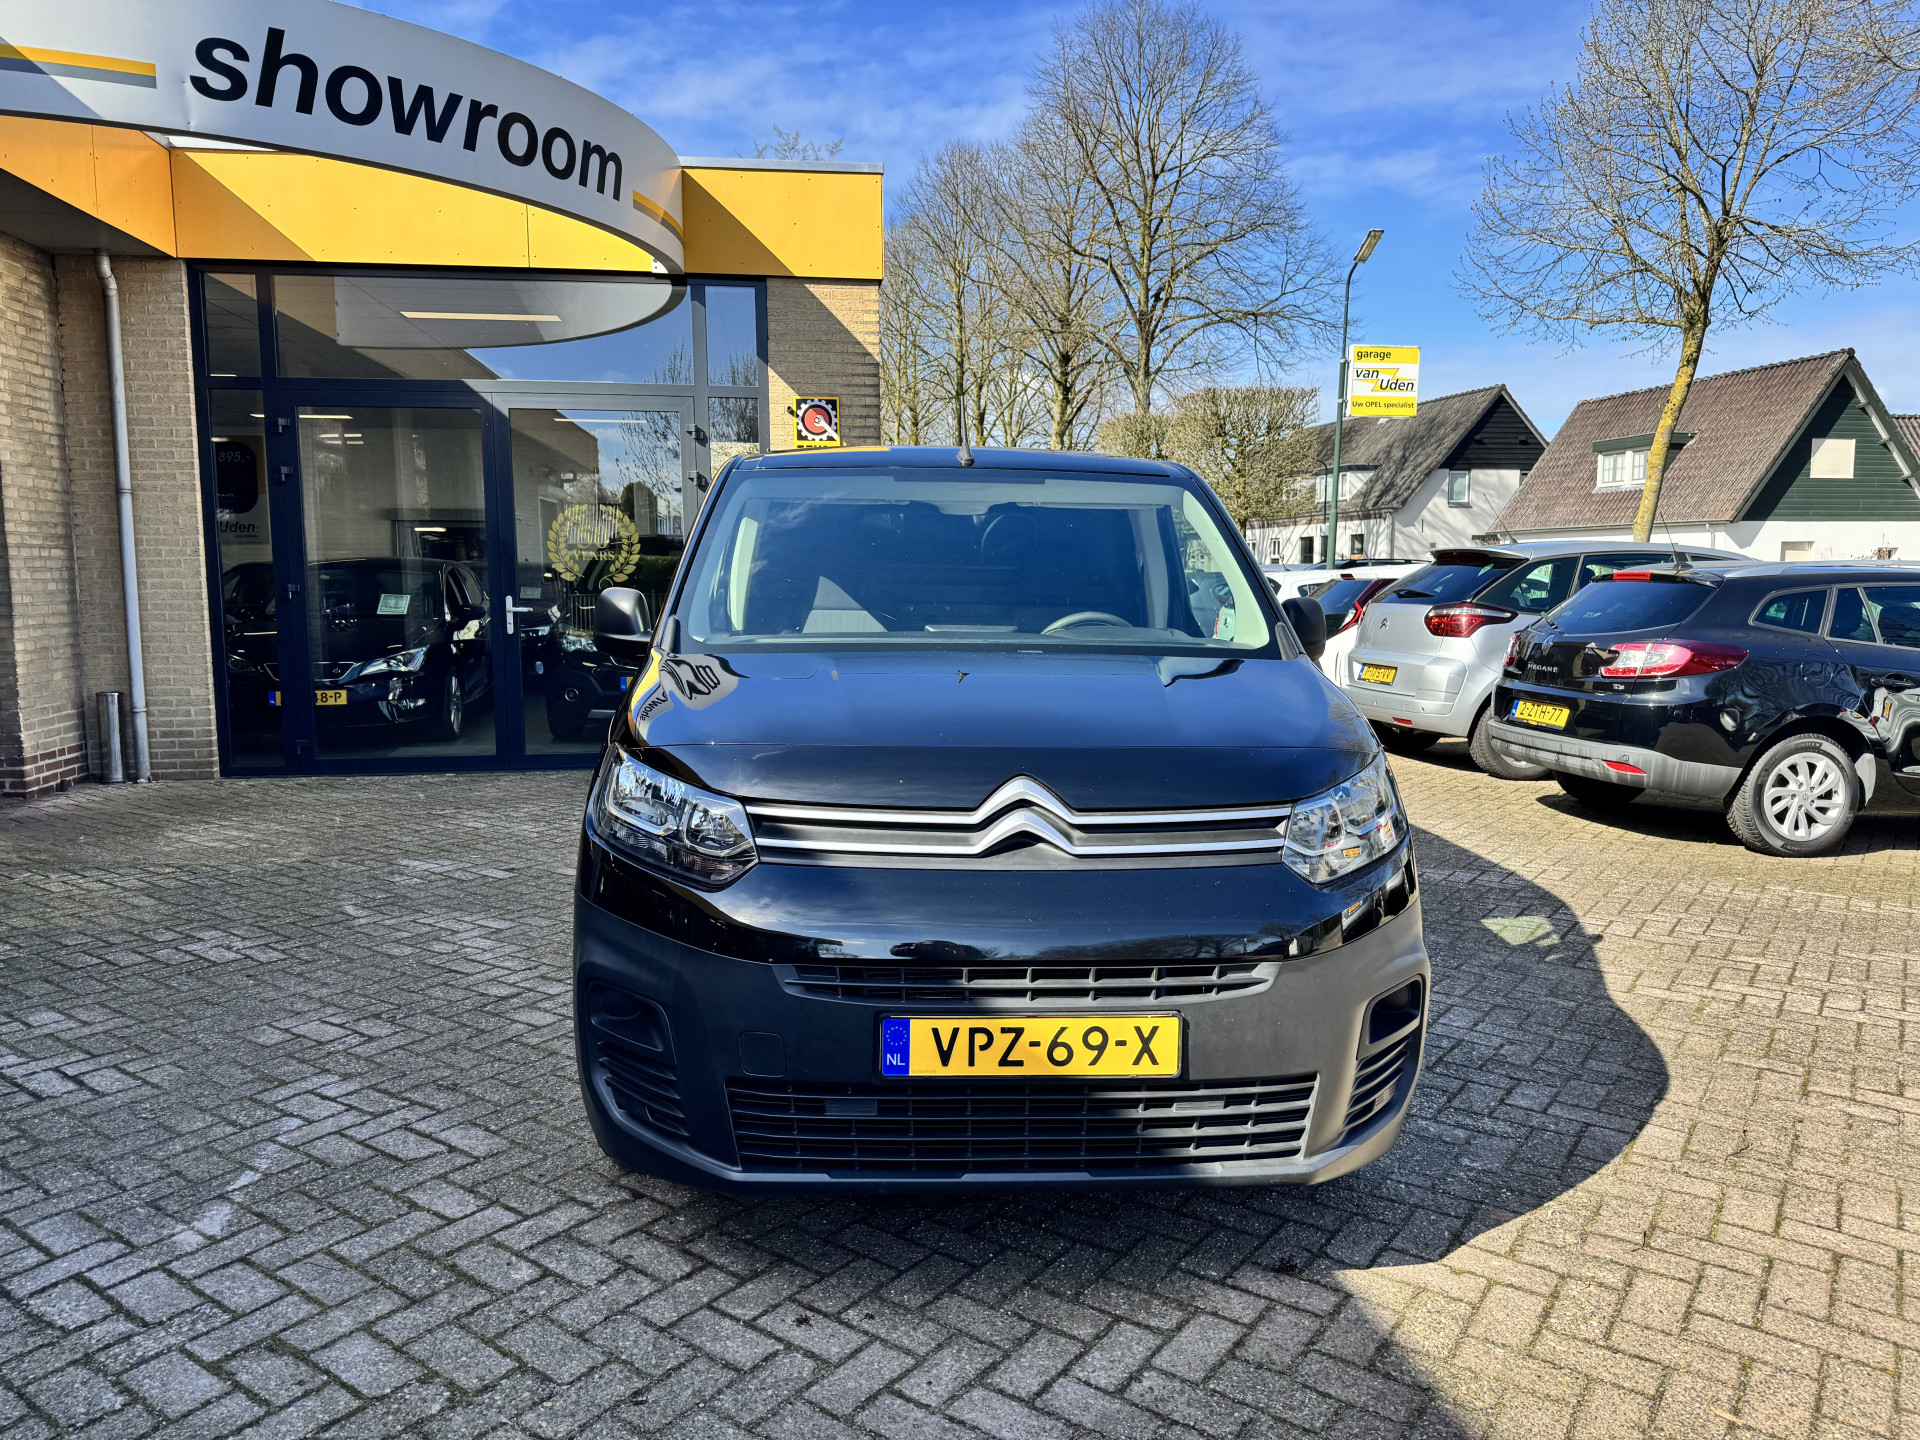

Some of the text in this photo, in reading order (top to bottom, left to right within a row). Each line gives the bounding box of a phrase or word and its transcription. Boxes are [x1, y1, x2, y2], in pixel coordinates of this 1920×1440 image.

[188, 26, 624, 202] showroom
[1356, 350, 1391, 360] garage
[1356, 369, 1379, 378] van
[1379, 378, 1415, 391] Uden
[219, 521, 255, 533] Uden
[573, 550, 616, 561] YEARS
[1520, 702, 1563, 721] 2-ZTH-77
[886, 1025, 1160, 1067] NL VPZ-69-X
